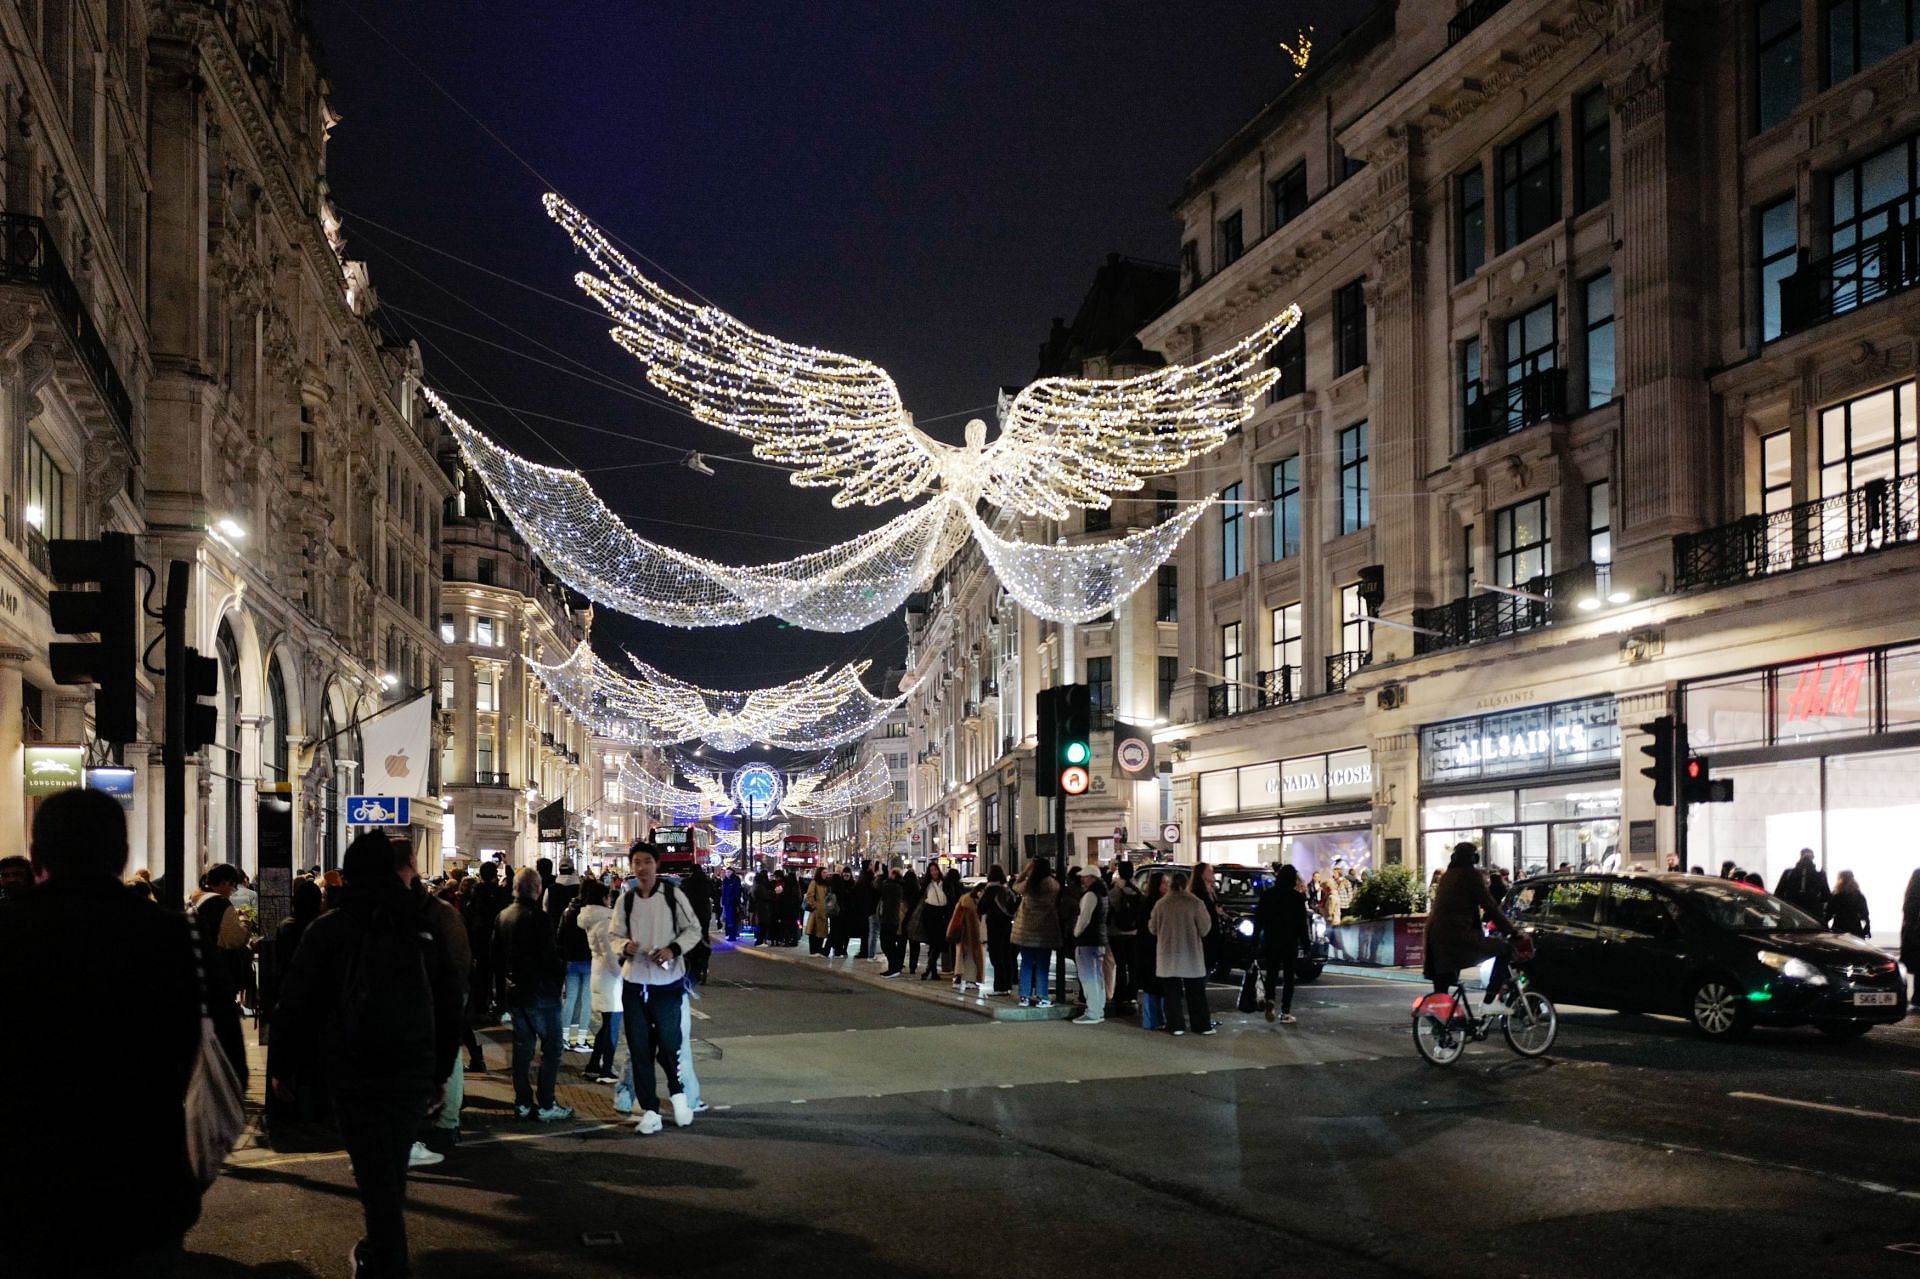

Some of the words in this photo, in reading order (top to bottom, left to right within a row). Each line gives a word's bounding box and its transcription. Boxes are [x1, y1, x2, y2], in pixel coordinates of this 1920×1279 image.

[1476, 690, 1535, 710] ALLSAINTS
[1455, 723, 1586, 764] ALLSAINTS
[1265, 773, 1320, 794] CANADA
[1322, 764, 1372, 787] GOOSE
